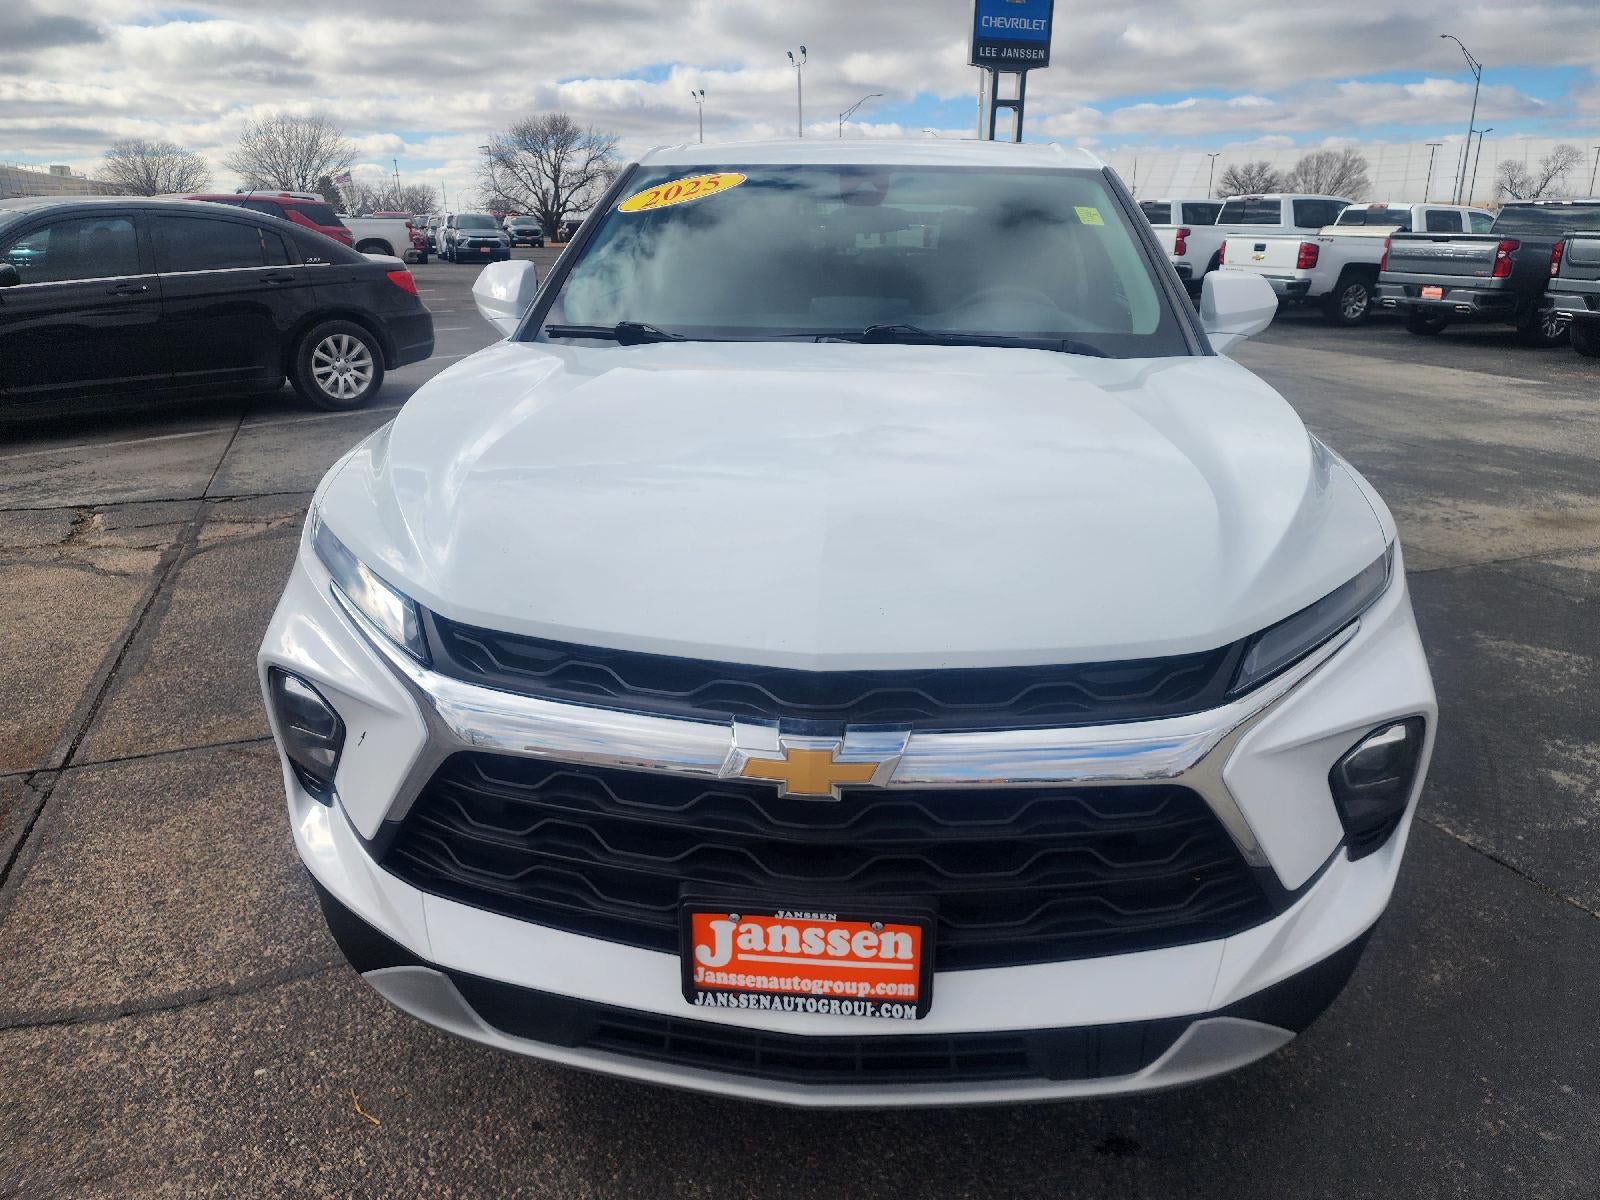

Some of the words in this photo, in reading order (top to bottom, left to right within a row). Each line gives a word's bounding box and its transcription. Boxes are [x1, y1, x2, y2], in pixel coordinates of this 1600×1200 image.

[982, 16, 1047, 30] CHEVROLET
[979, 47, 998, 57] LEE
[1001, 48, 1045, 59] JANSSEN
[641, 175, 722, 208] 2025
[774, 910, 837, 920] JANSSEN
[695, 919, 914, 967] Janssen
[693, 966, 915, 998] Janssenautogroup.com
[694, 991, 918, 1020] JANSSENAUTOGROUP.COM
